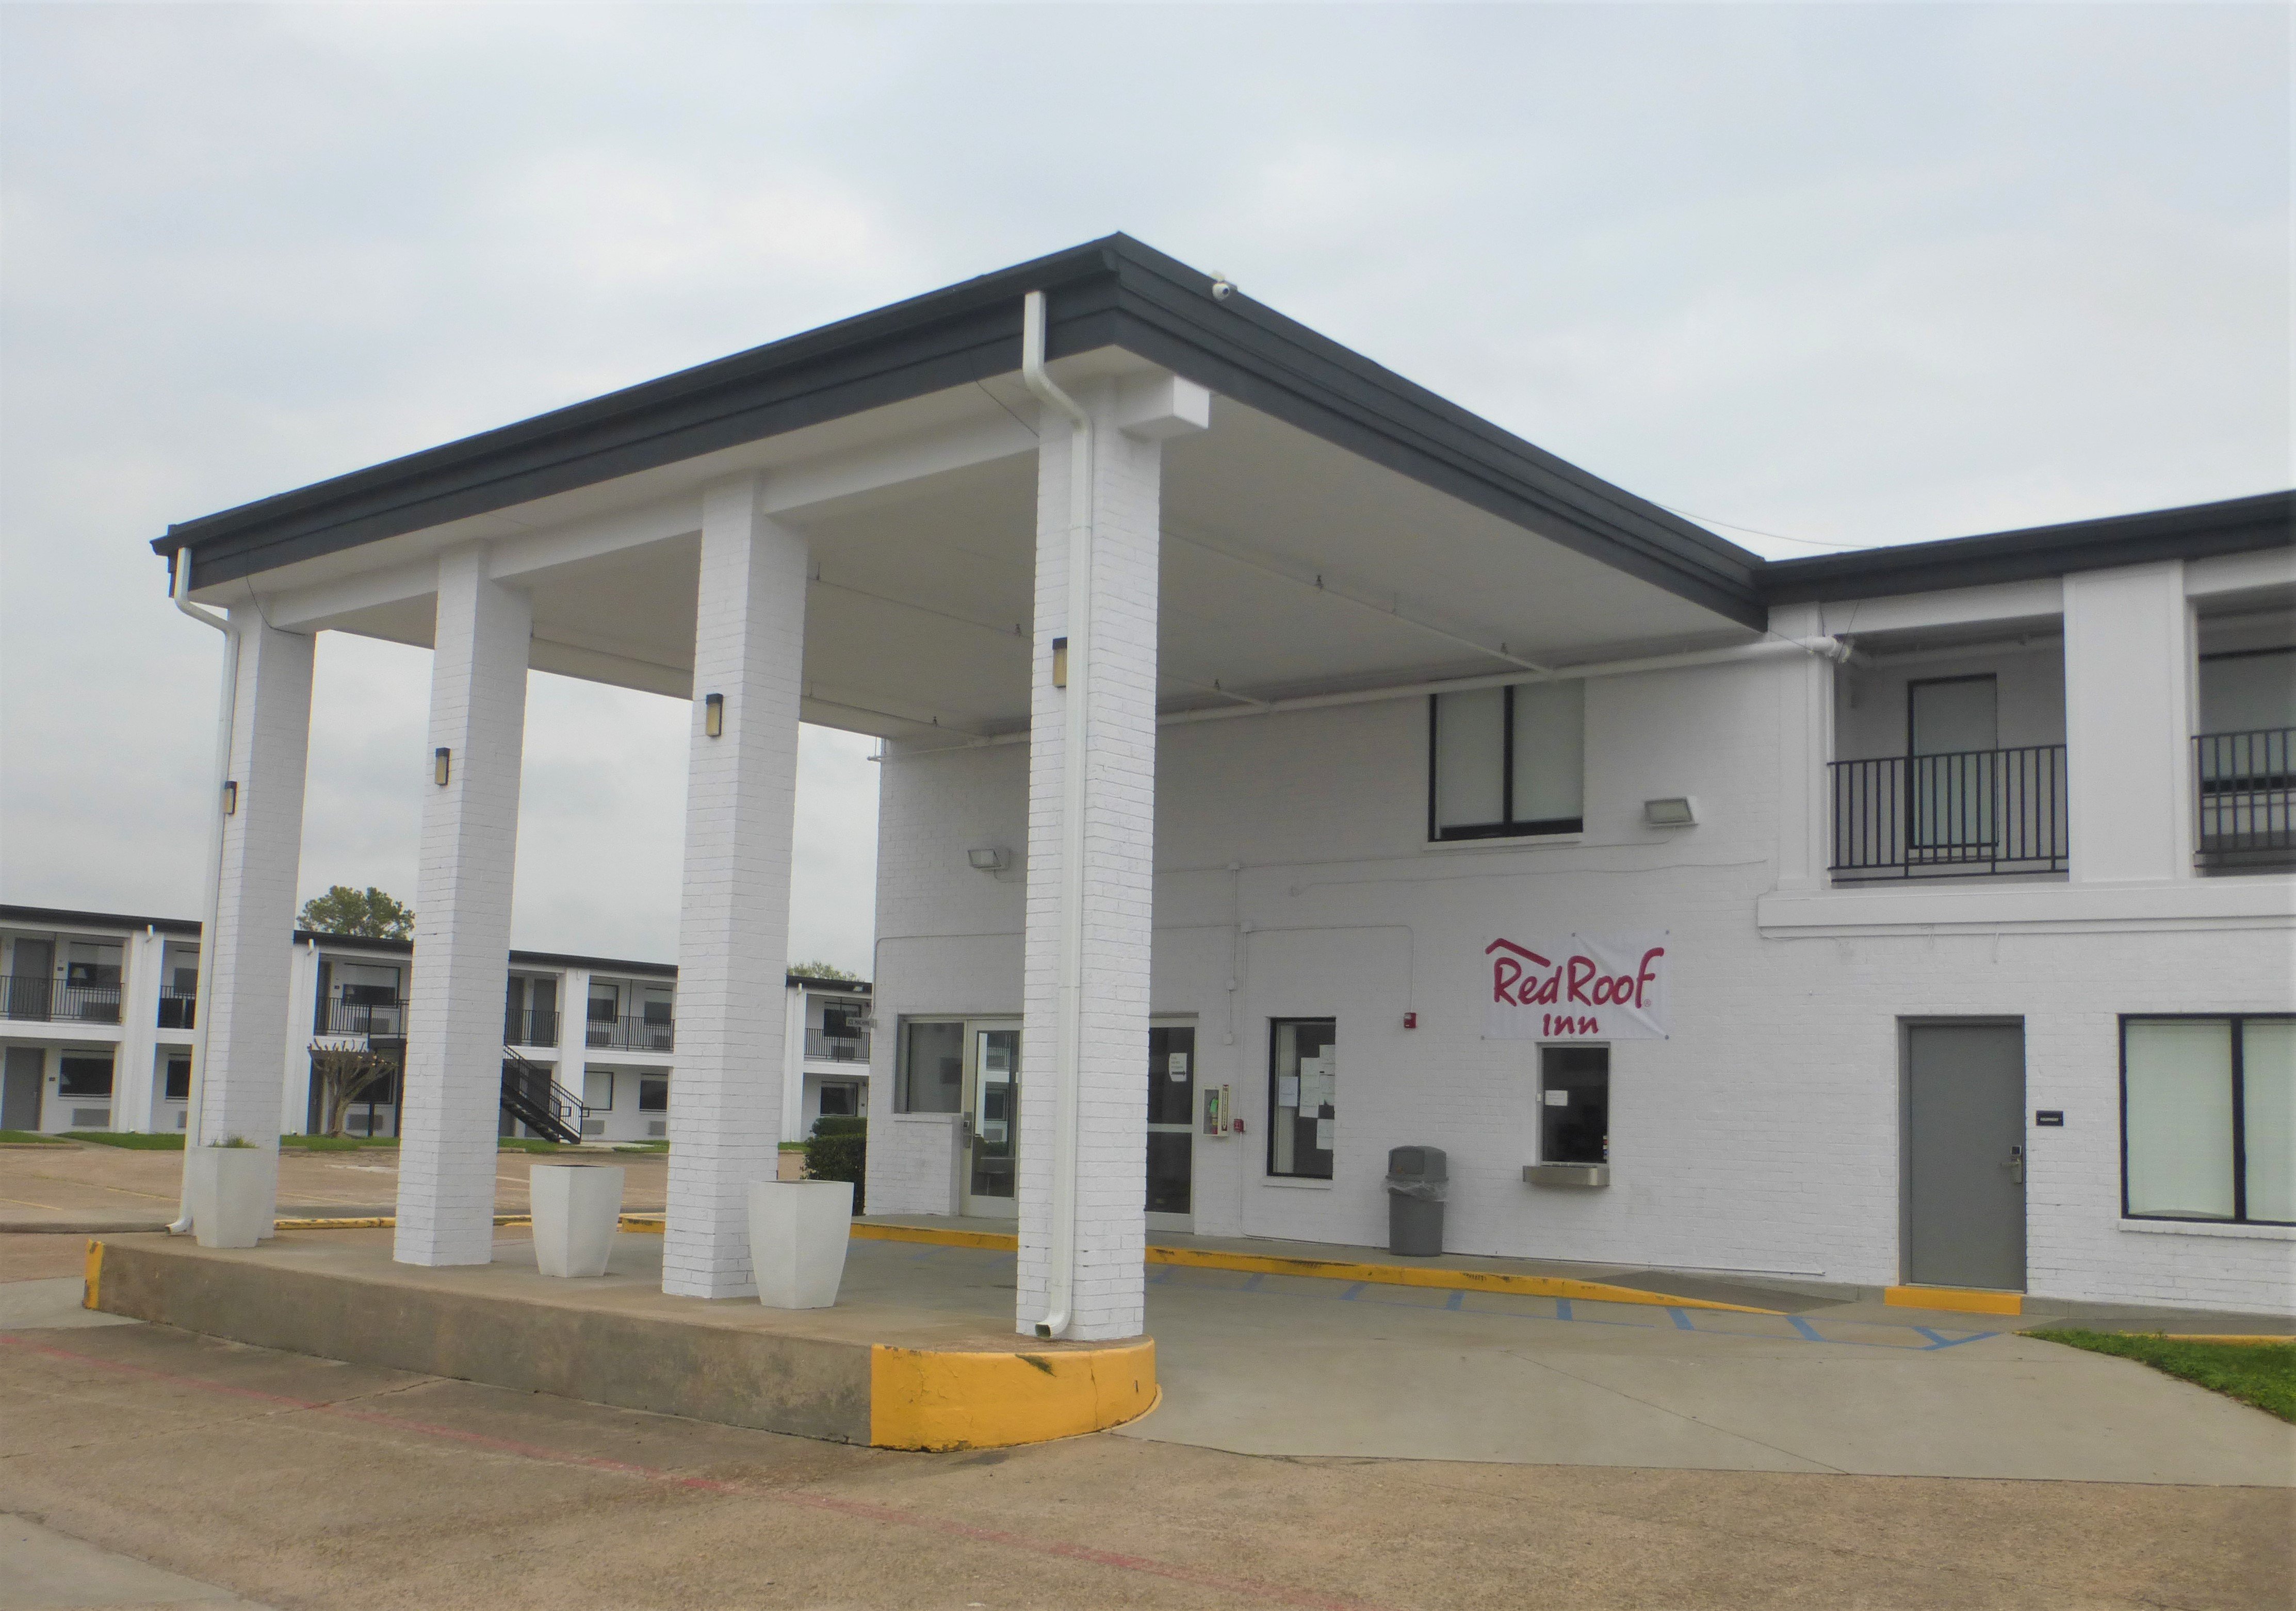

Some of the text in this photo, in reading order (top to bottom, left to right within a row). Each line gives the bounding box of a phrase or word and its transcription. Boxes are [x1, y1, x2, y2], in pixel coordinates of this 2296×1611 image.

[1494, 947, 1665, 1009] Red Roof
[1543, 1013, 1599, 1037] Inn
